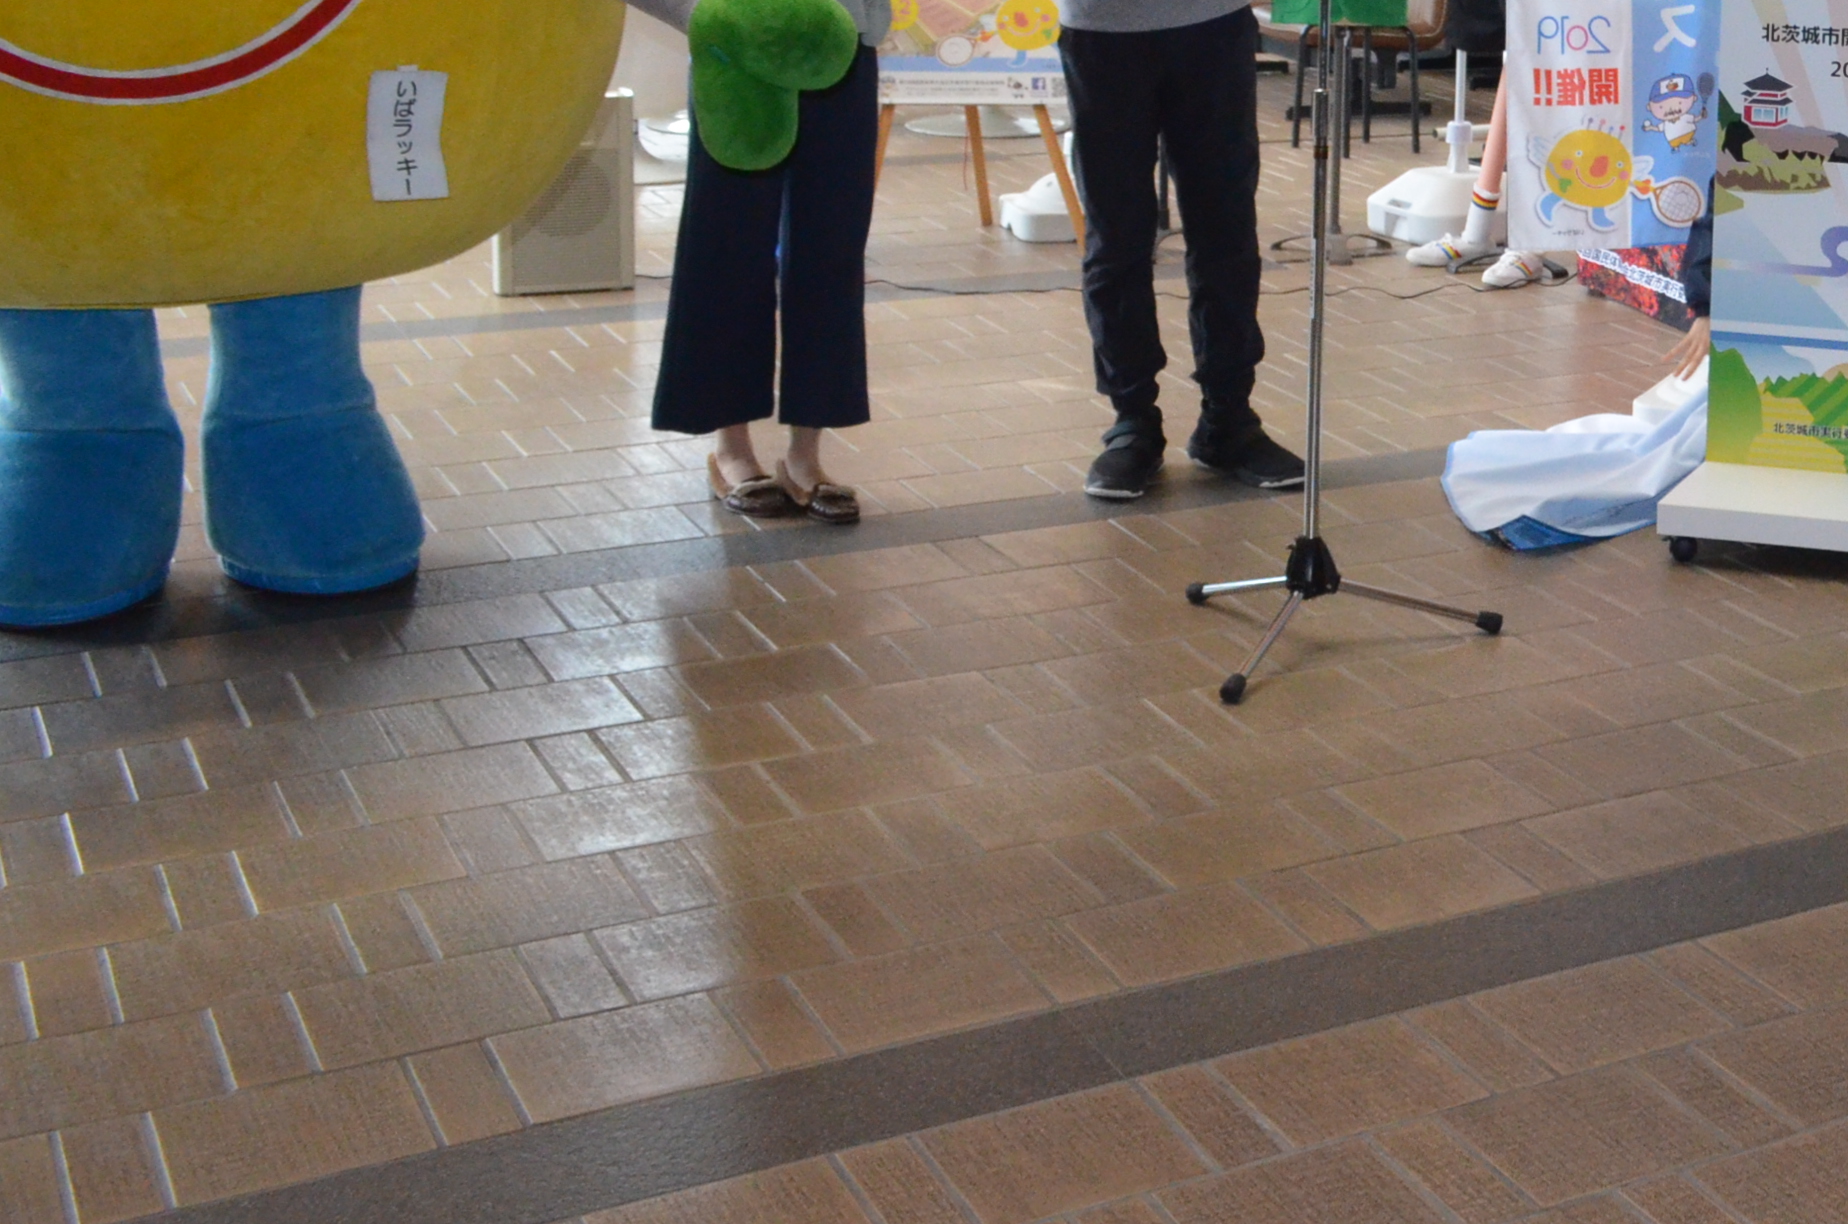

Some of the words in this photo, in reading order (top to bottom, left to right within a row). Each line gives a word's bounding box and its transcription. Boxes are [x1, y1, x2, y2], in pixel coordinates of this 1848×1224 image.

[393, 80, 418, 196] いばラッキー
